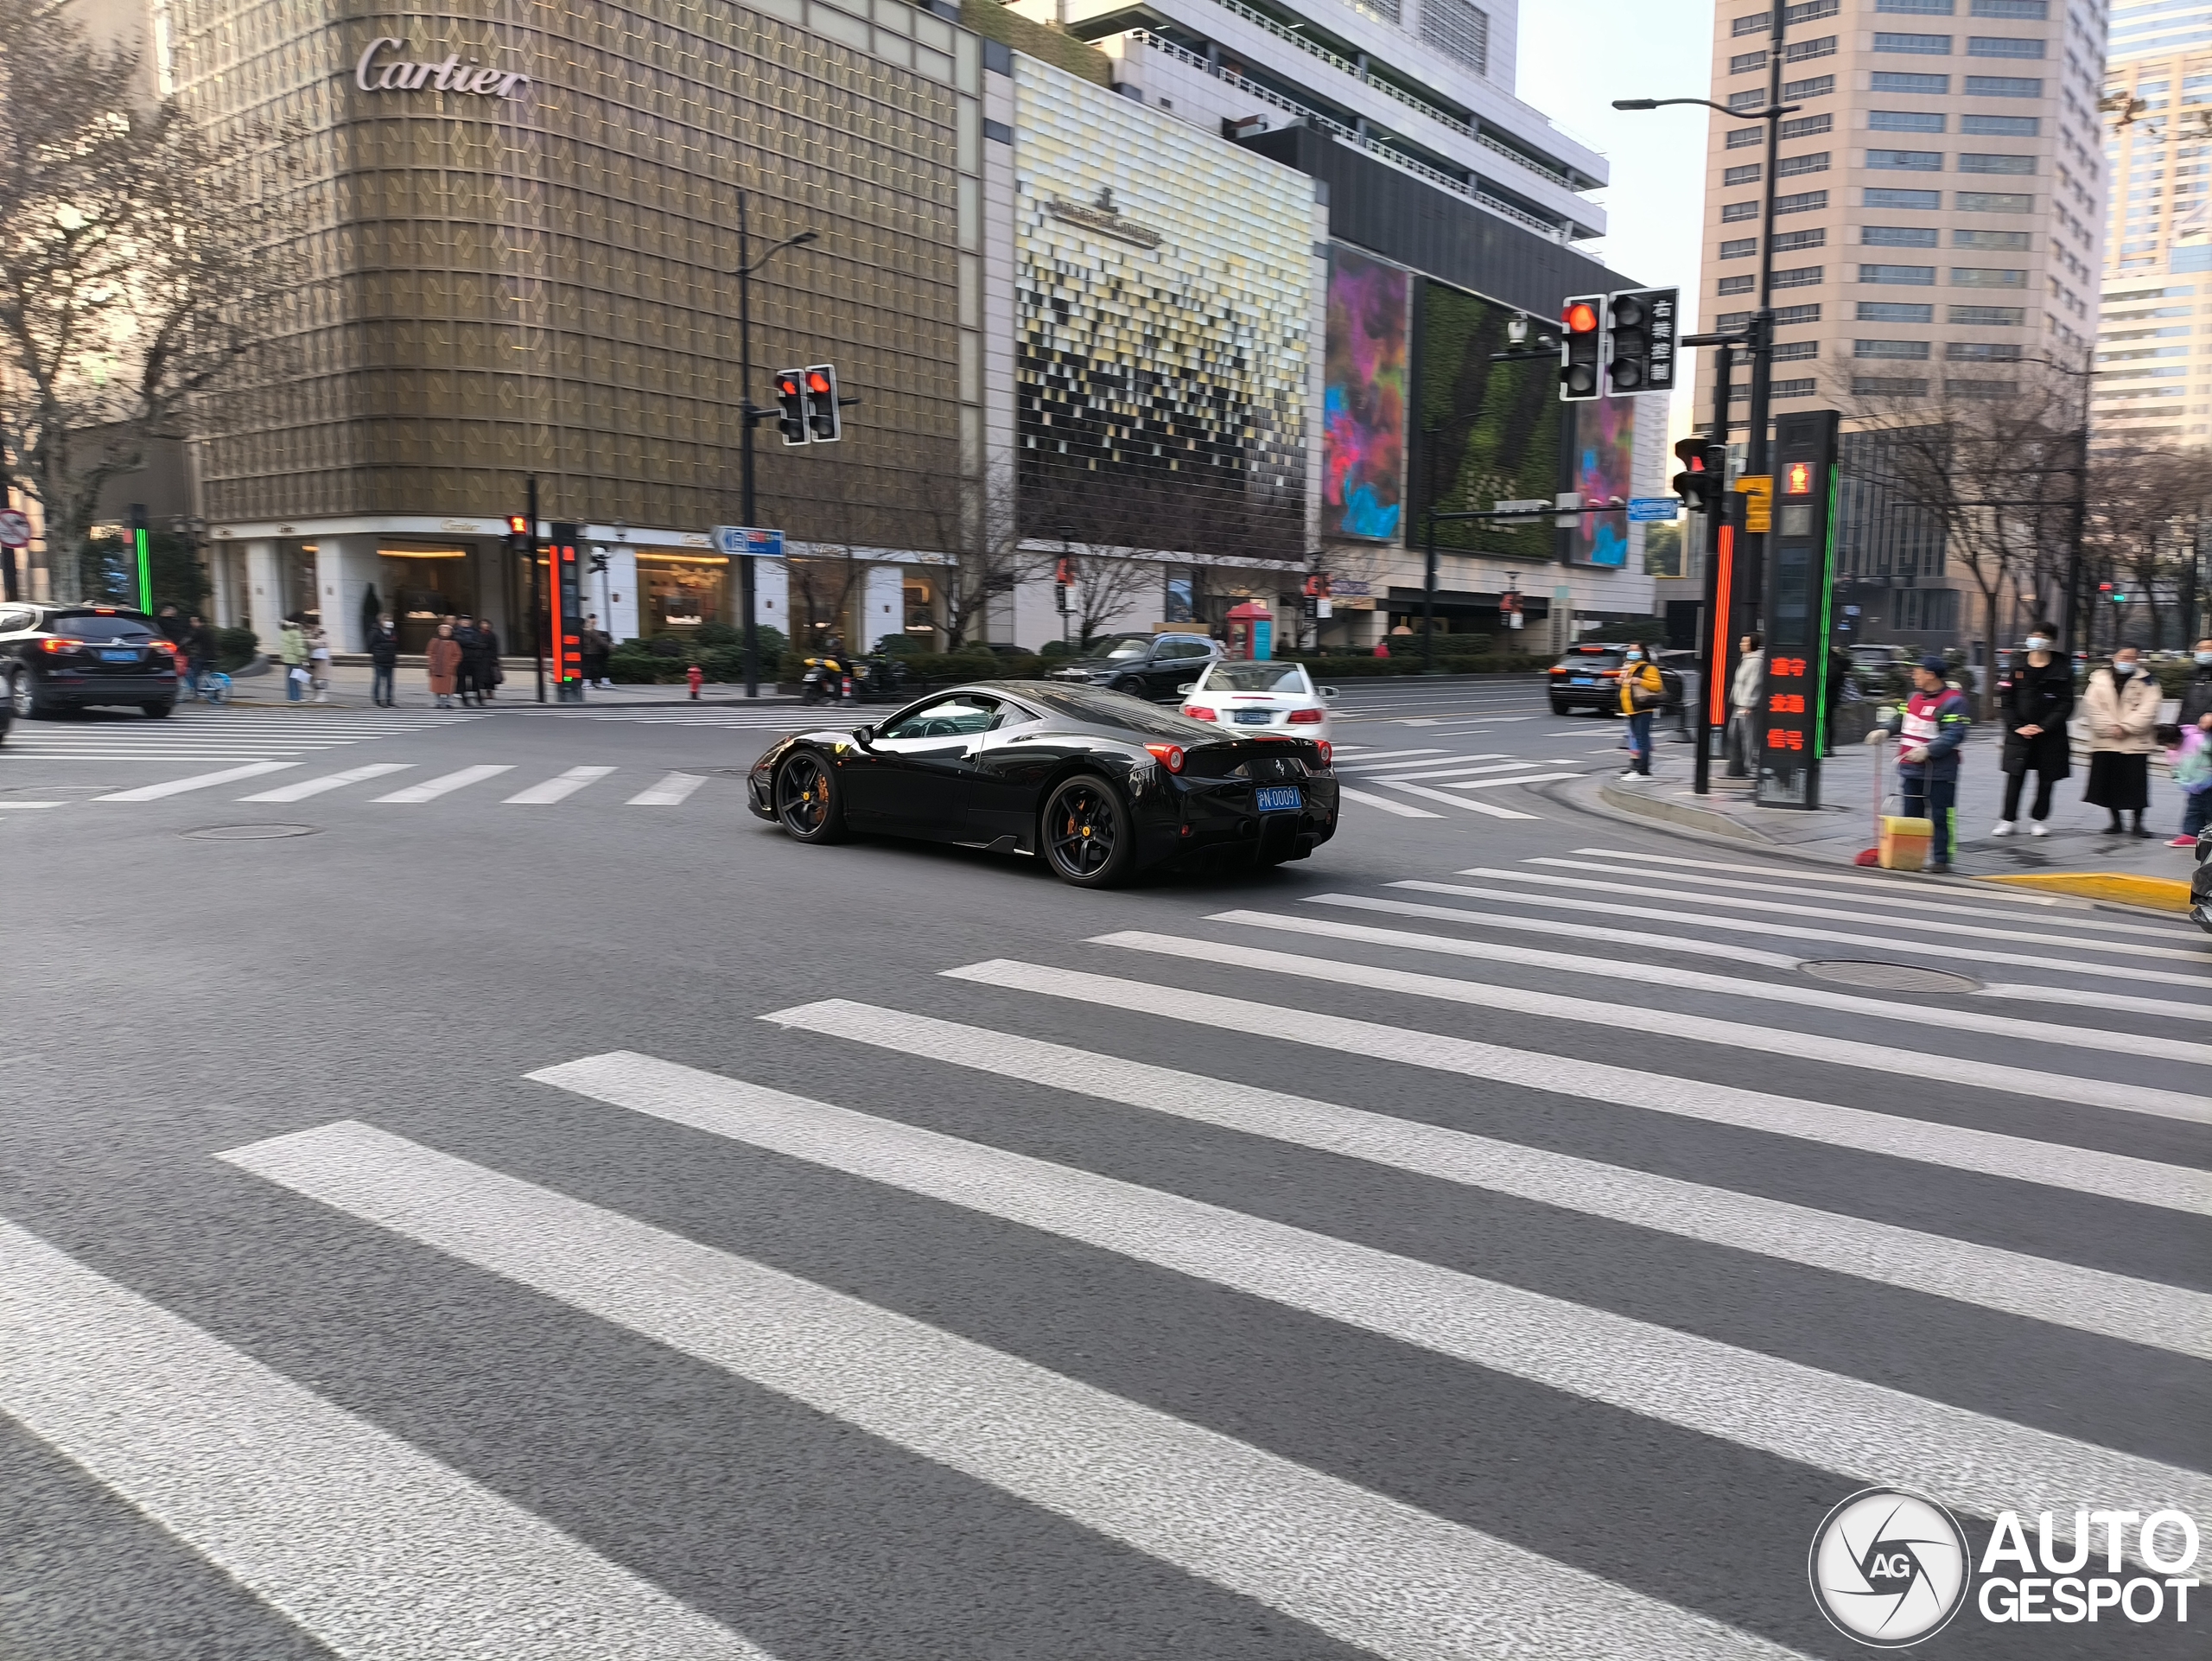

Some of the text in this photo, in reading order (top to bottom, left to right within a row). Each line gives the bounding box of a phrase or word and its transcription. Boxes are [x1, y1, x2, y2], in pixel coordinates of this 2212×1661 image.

[356, 36, 531, 97] Cartier
[1769, 693, 1805, 713] 交通
[1766, 729, 1804, 750] 信号
